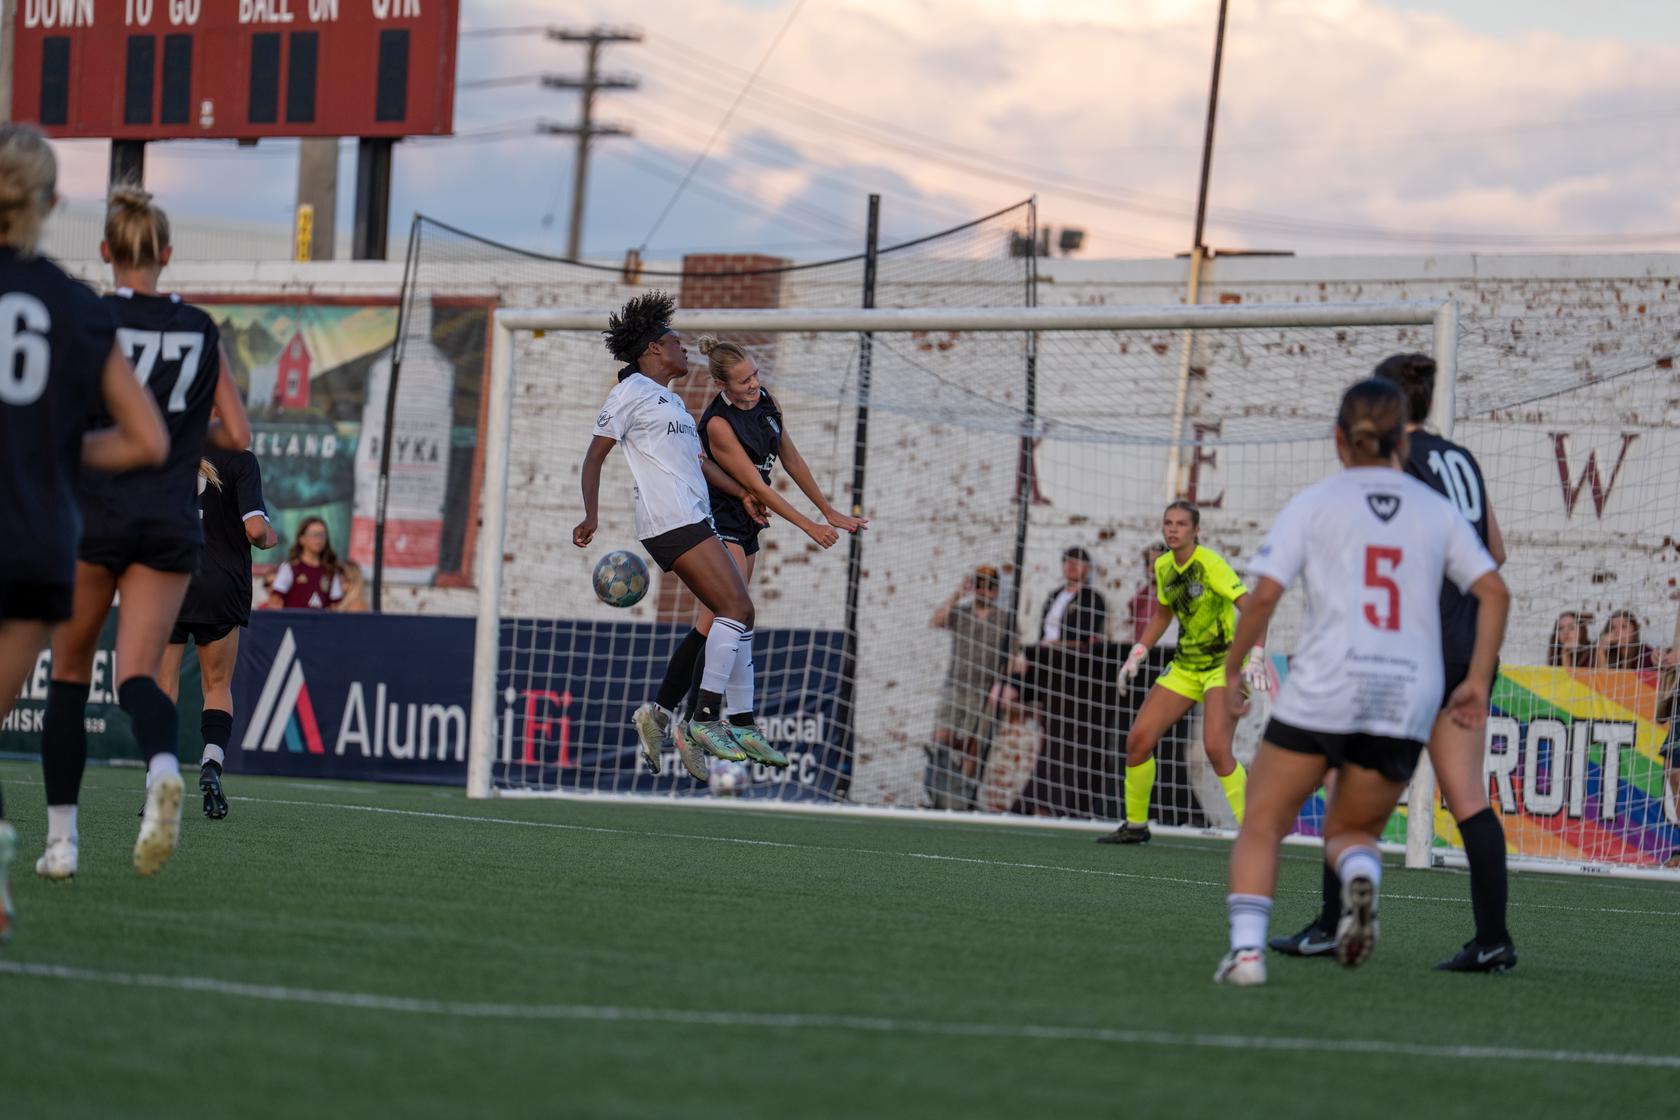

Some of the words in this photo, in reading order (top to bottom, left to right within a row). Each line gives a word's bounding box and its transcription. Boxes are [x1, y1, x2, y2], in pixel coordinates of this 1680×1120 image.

[25, 0, 95, 28] DOWN
[168, 0, 201, 26] GO
[238, 0, 295, 24] BALL
[116, 328, 204, 413] 77
[251, 431, 337, 458] ELAND
[368, 436, 439, 462] RYKA
[1428, 449, 1482, 523] 10
[1363, 544, 1404, 632] 5
[335, 681, 578, 769] AlumiFi
[754, 711, 824, 742] ancial
[1484, 715, 1635, 822] ROIT
